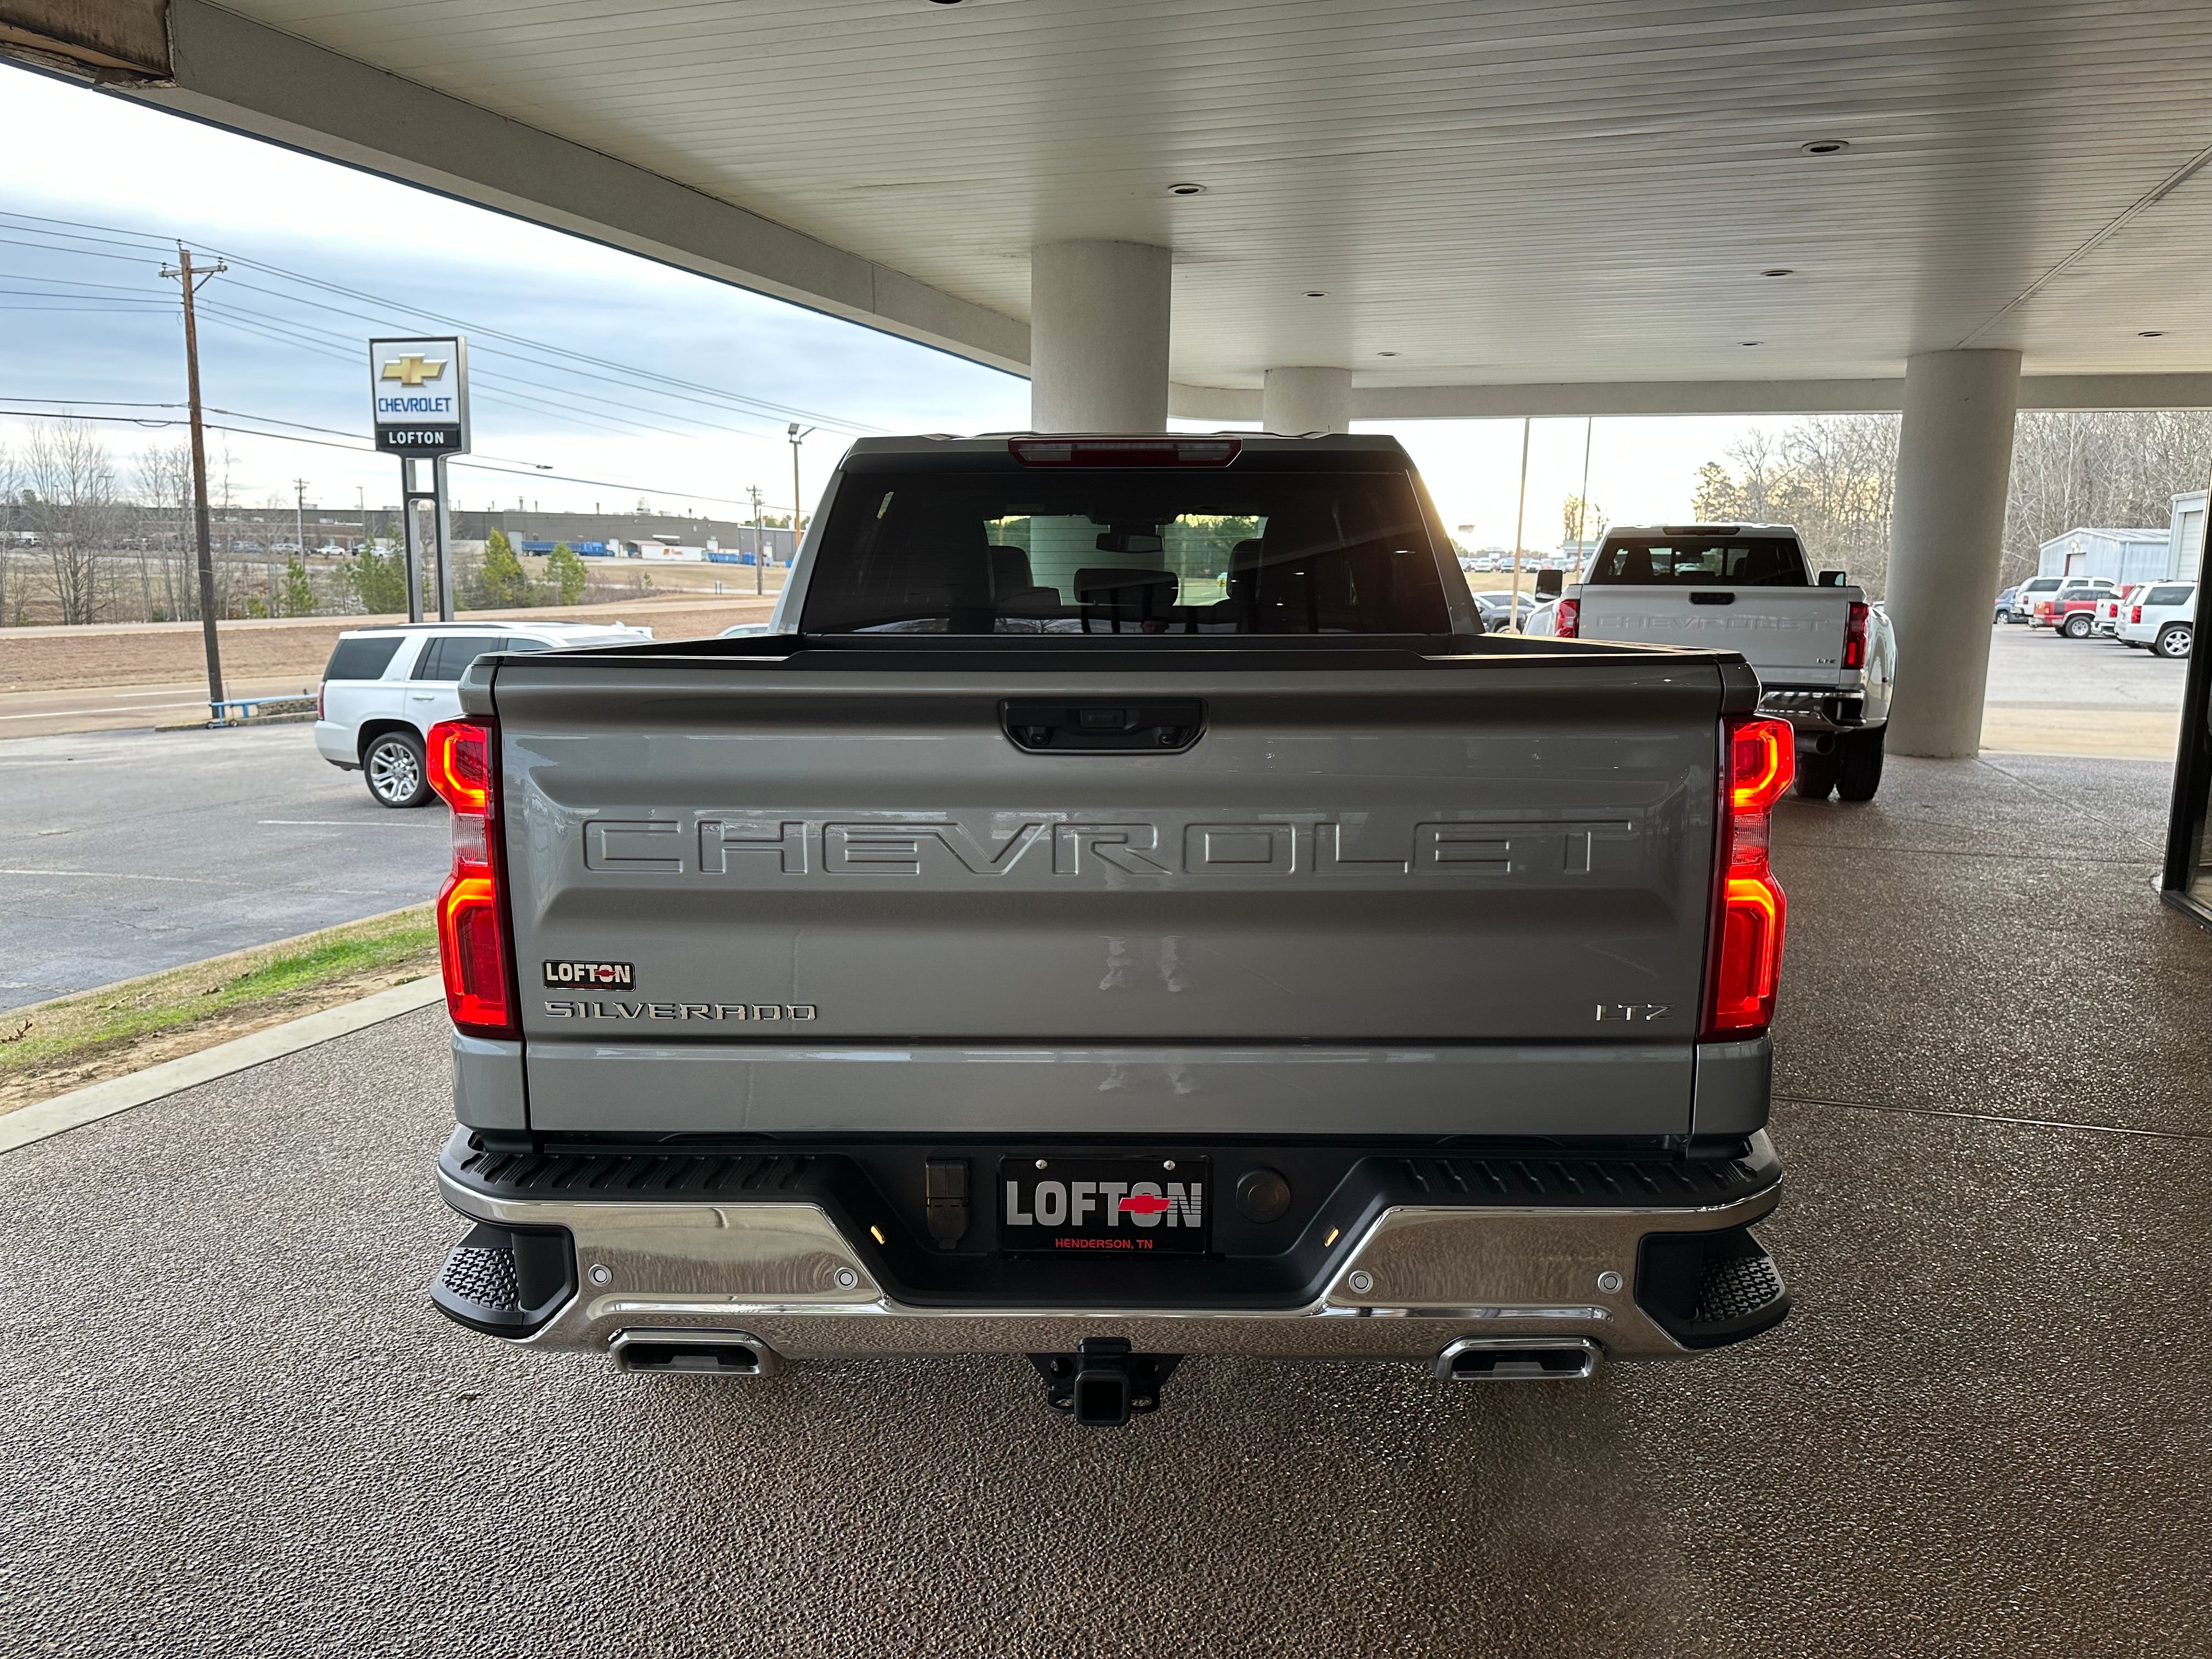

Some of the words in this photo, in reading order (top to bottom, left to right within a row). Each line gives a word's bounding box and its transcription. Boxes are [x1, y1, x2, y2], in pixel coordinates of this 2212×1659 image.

[378, 398, 452, 412] CHEVROLET
[388, 431, 444, 444] LOFTON
[1596, 616, 1827, 632] CHEVROLET
[582, 819, 1633, 874] CHEVROLET
[546, 963, 631, 983] LOFTON
[544, 1001, 817, 1021] SILVERADO
[1595, 1003, 1675, 1022] LTZ
[1006, 1181, 1202, 1227] LOFTON
[1055, 1238, 1134, 1250] HENDERSON,
[1136, 1239, 1153, 1249] TN
